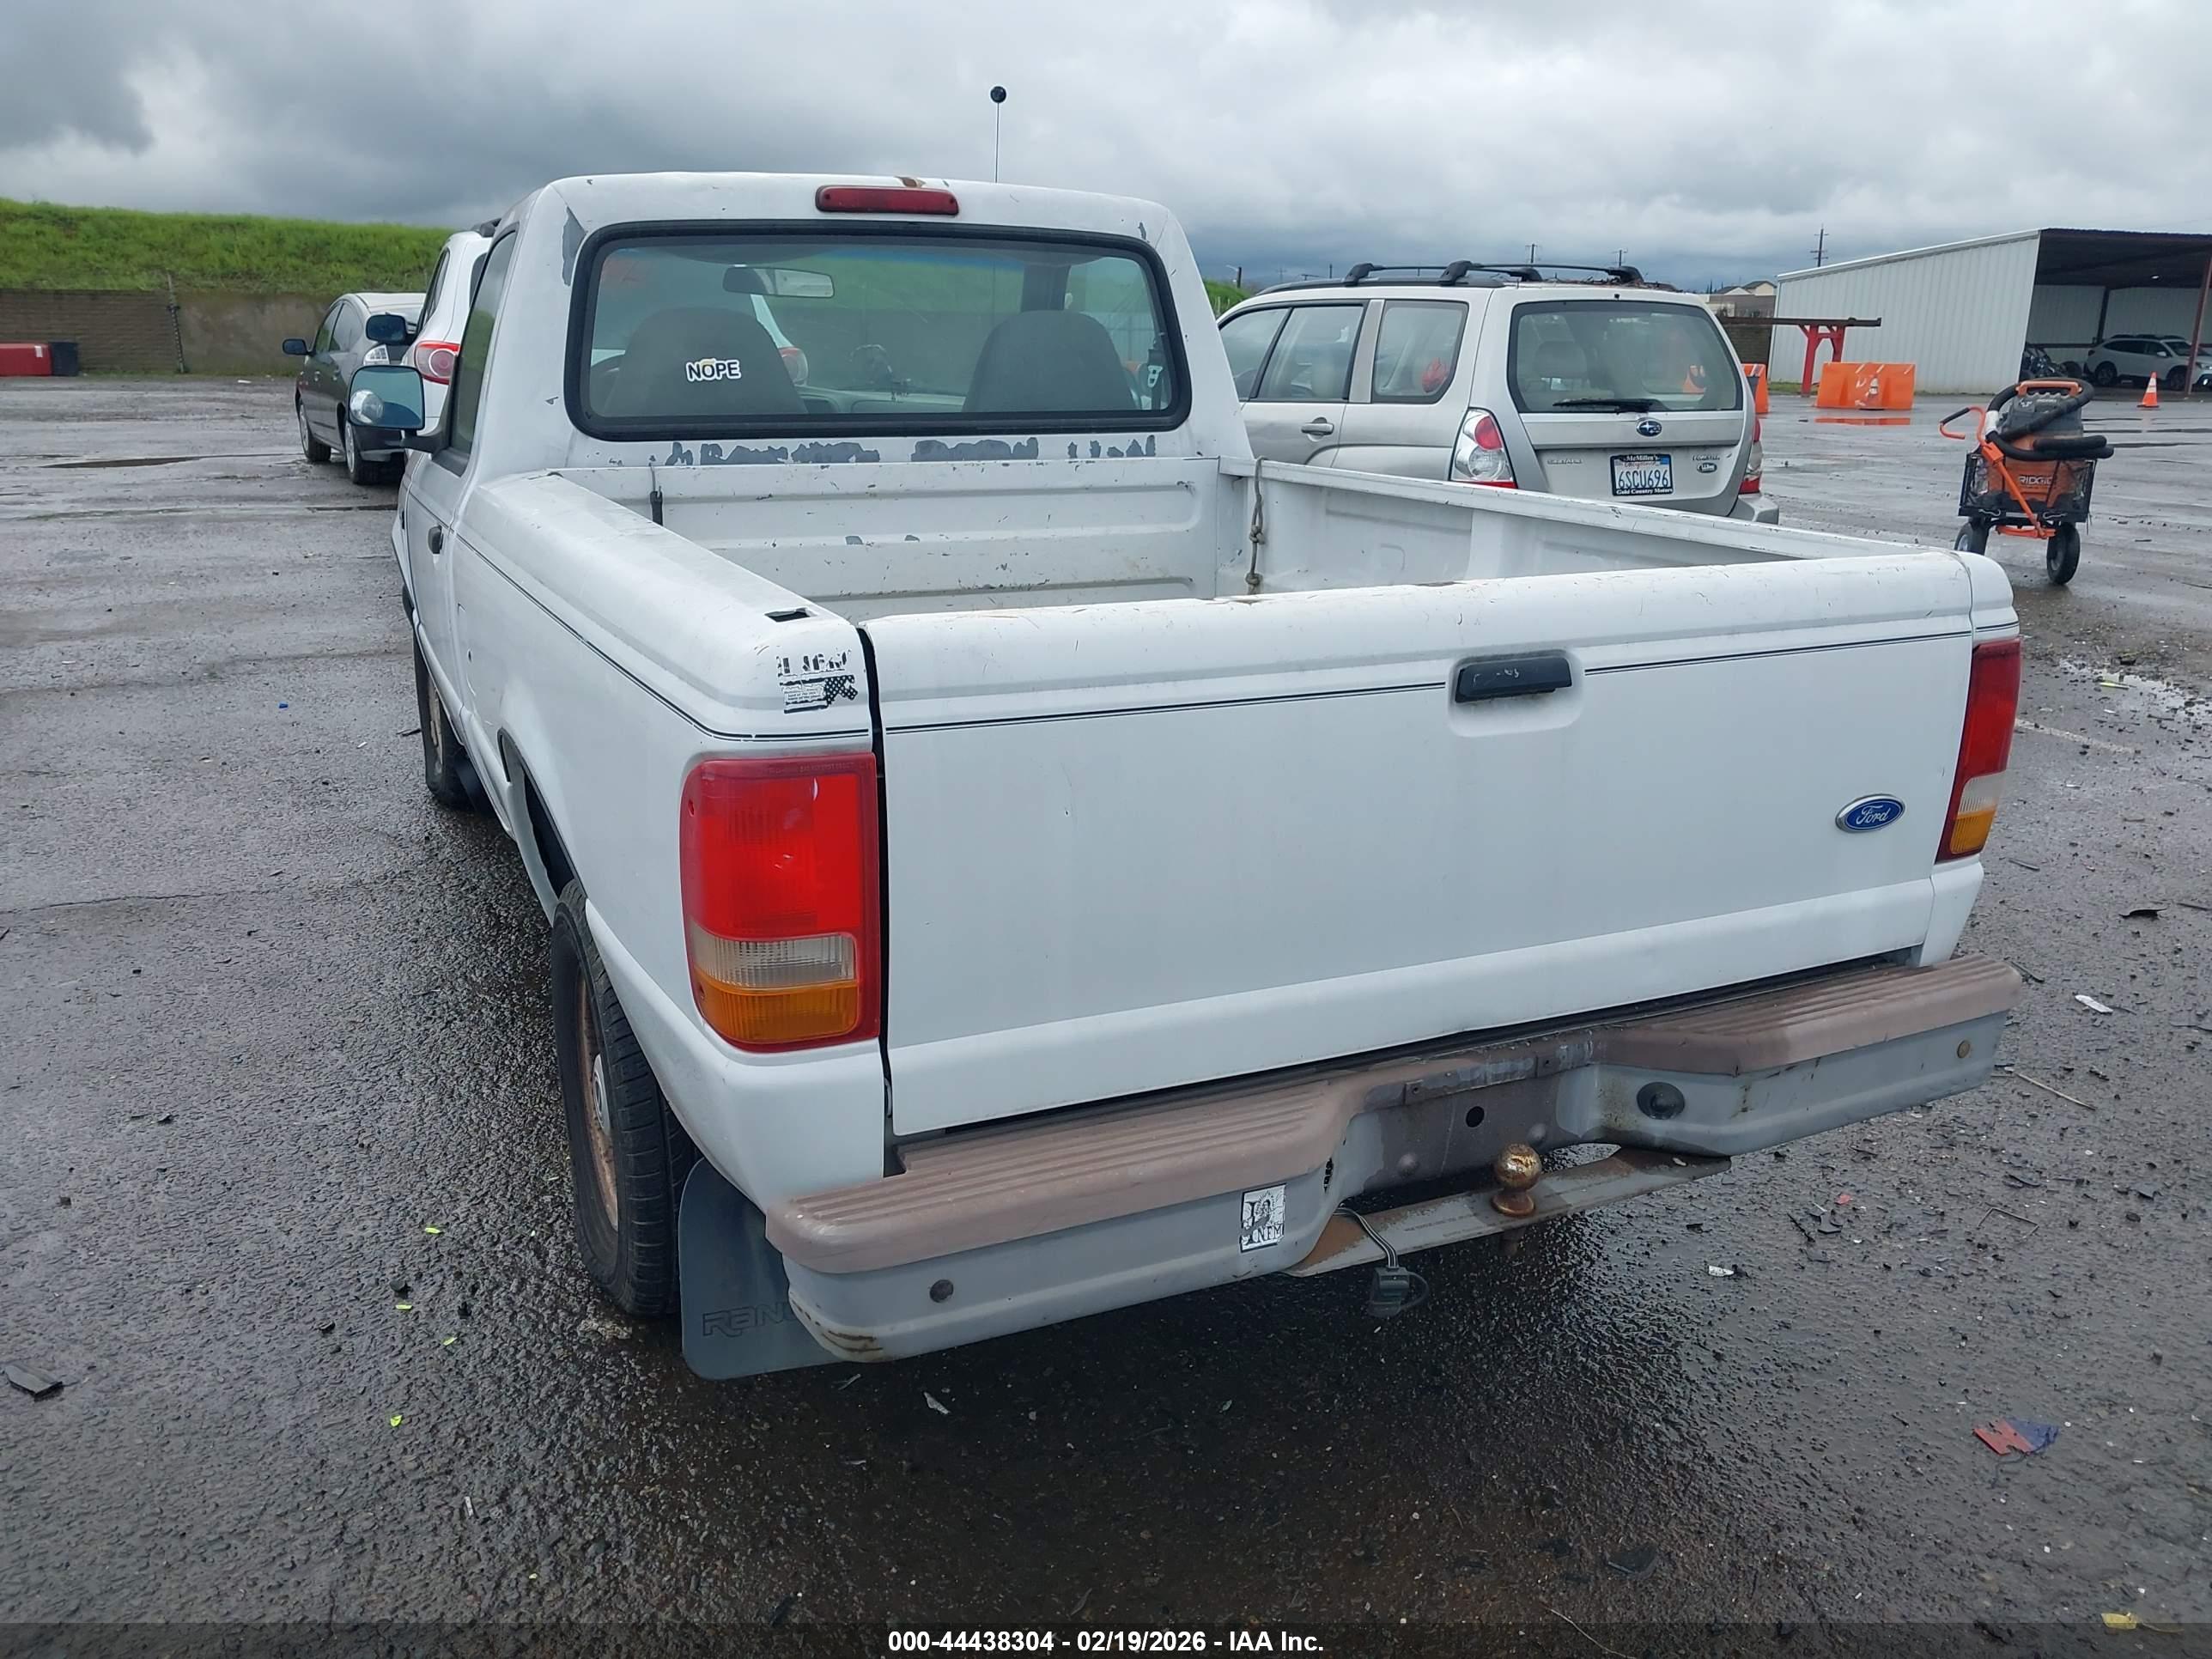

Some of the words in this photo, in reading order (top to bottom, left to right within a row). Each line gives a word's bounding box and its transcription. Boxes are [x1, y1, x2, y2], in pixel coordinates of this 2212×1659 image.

[687, 360, 740, 380] NOPE
[1619, 469, 1668, 489] 6SCU696
[1856, 804, 1892, 825] Ford
